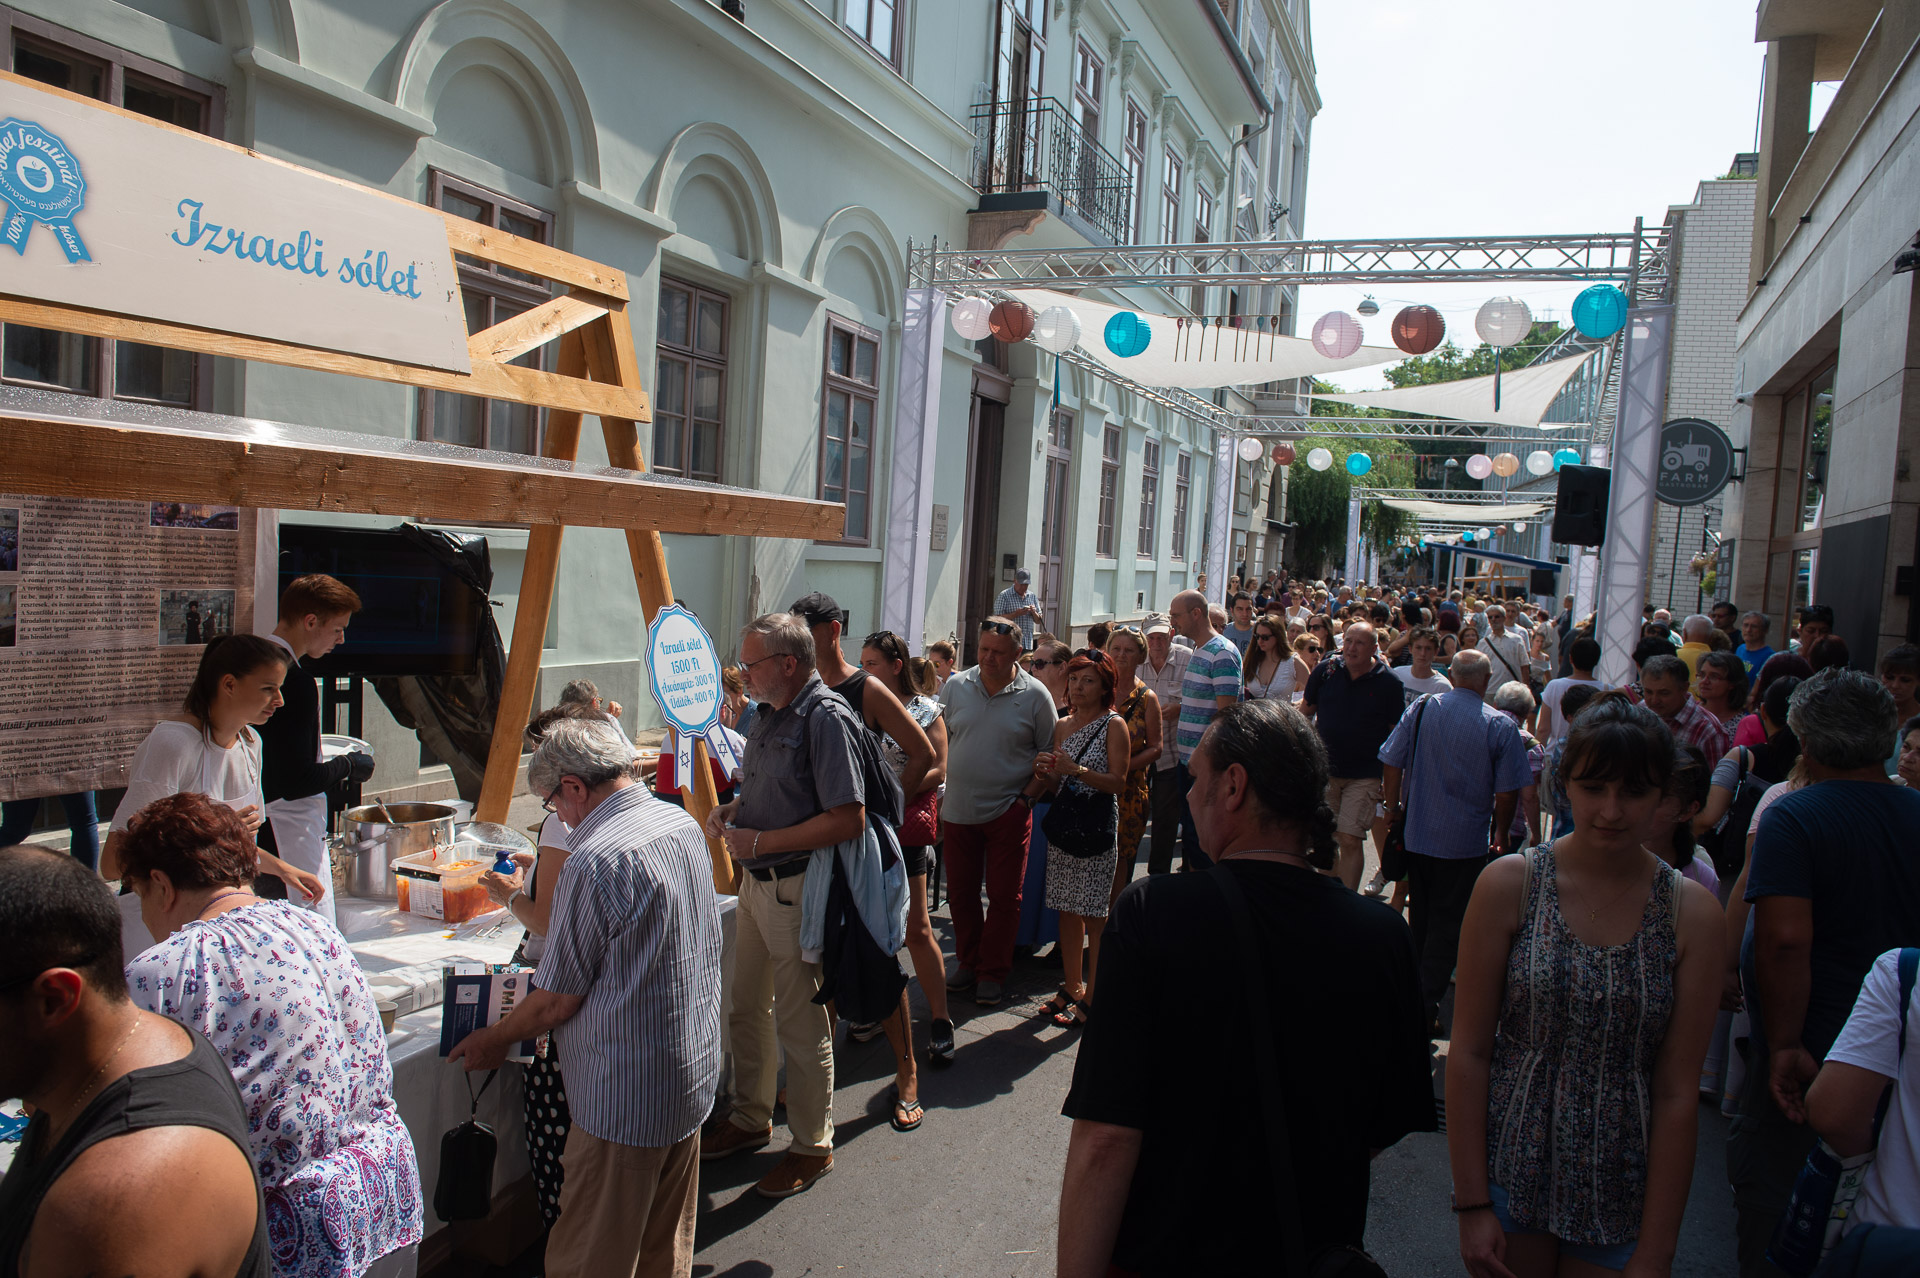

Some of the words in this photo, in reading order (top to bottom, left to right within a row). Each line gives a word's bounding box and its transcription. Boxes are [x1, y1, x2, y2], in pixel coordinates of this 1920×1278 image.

[171, 199, 328, 277] Izraeli
[338, 250, 422, 299] sólet
[1660, 472, 1708, 482] FARM
[660, 640, 686, 655] Izraeli
[670, 658, 690, 674] 1500
[695, 674, 708, 686] 300
[694, 691, 707, 703] 400
